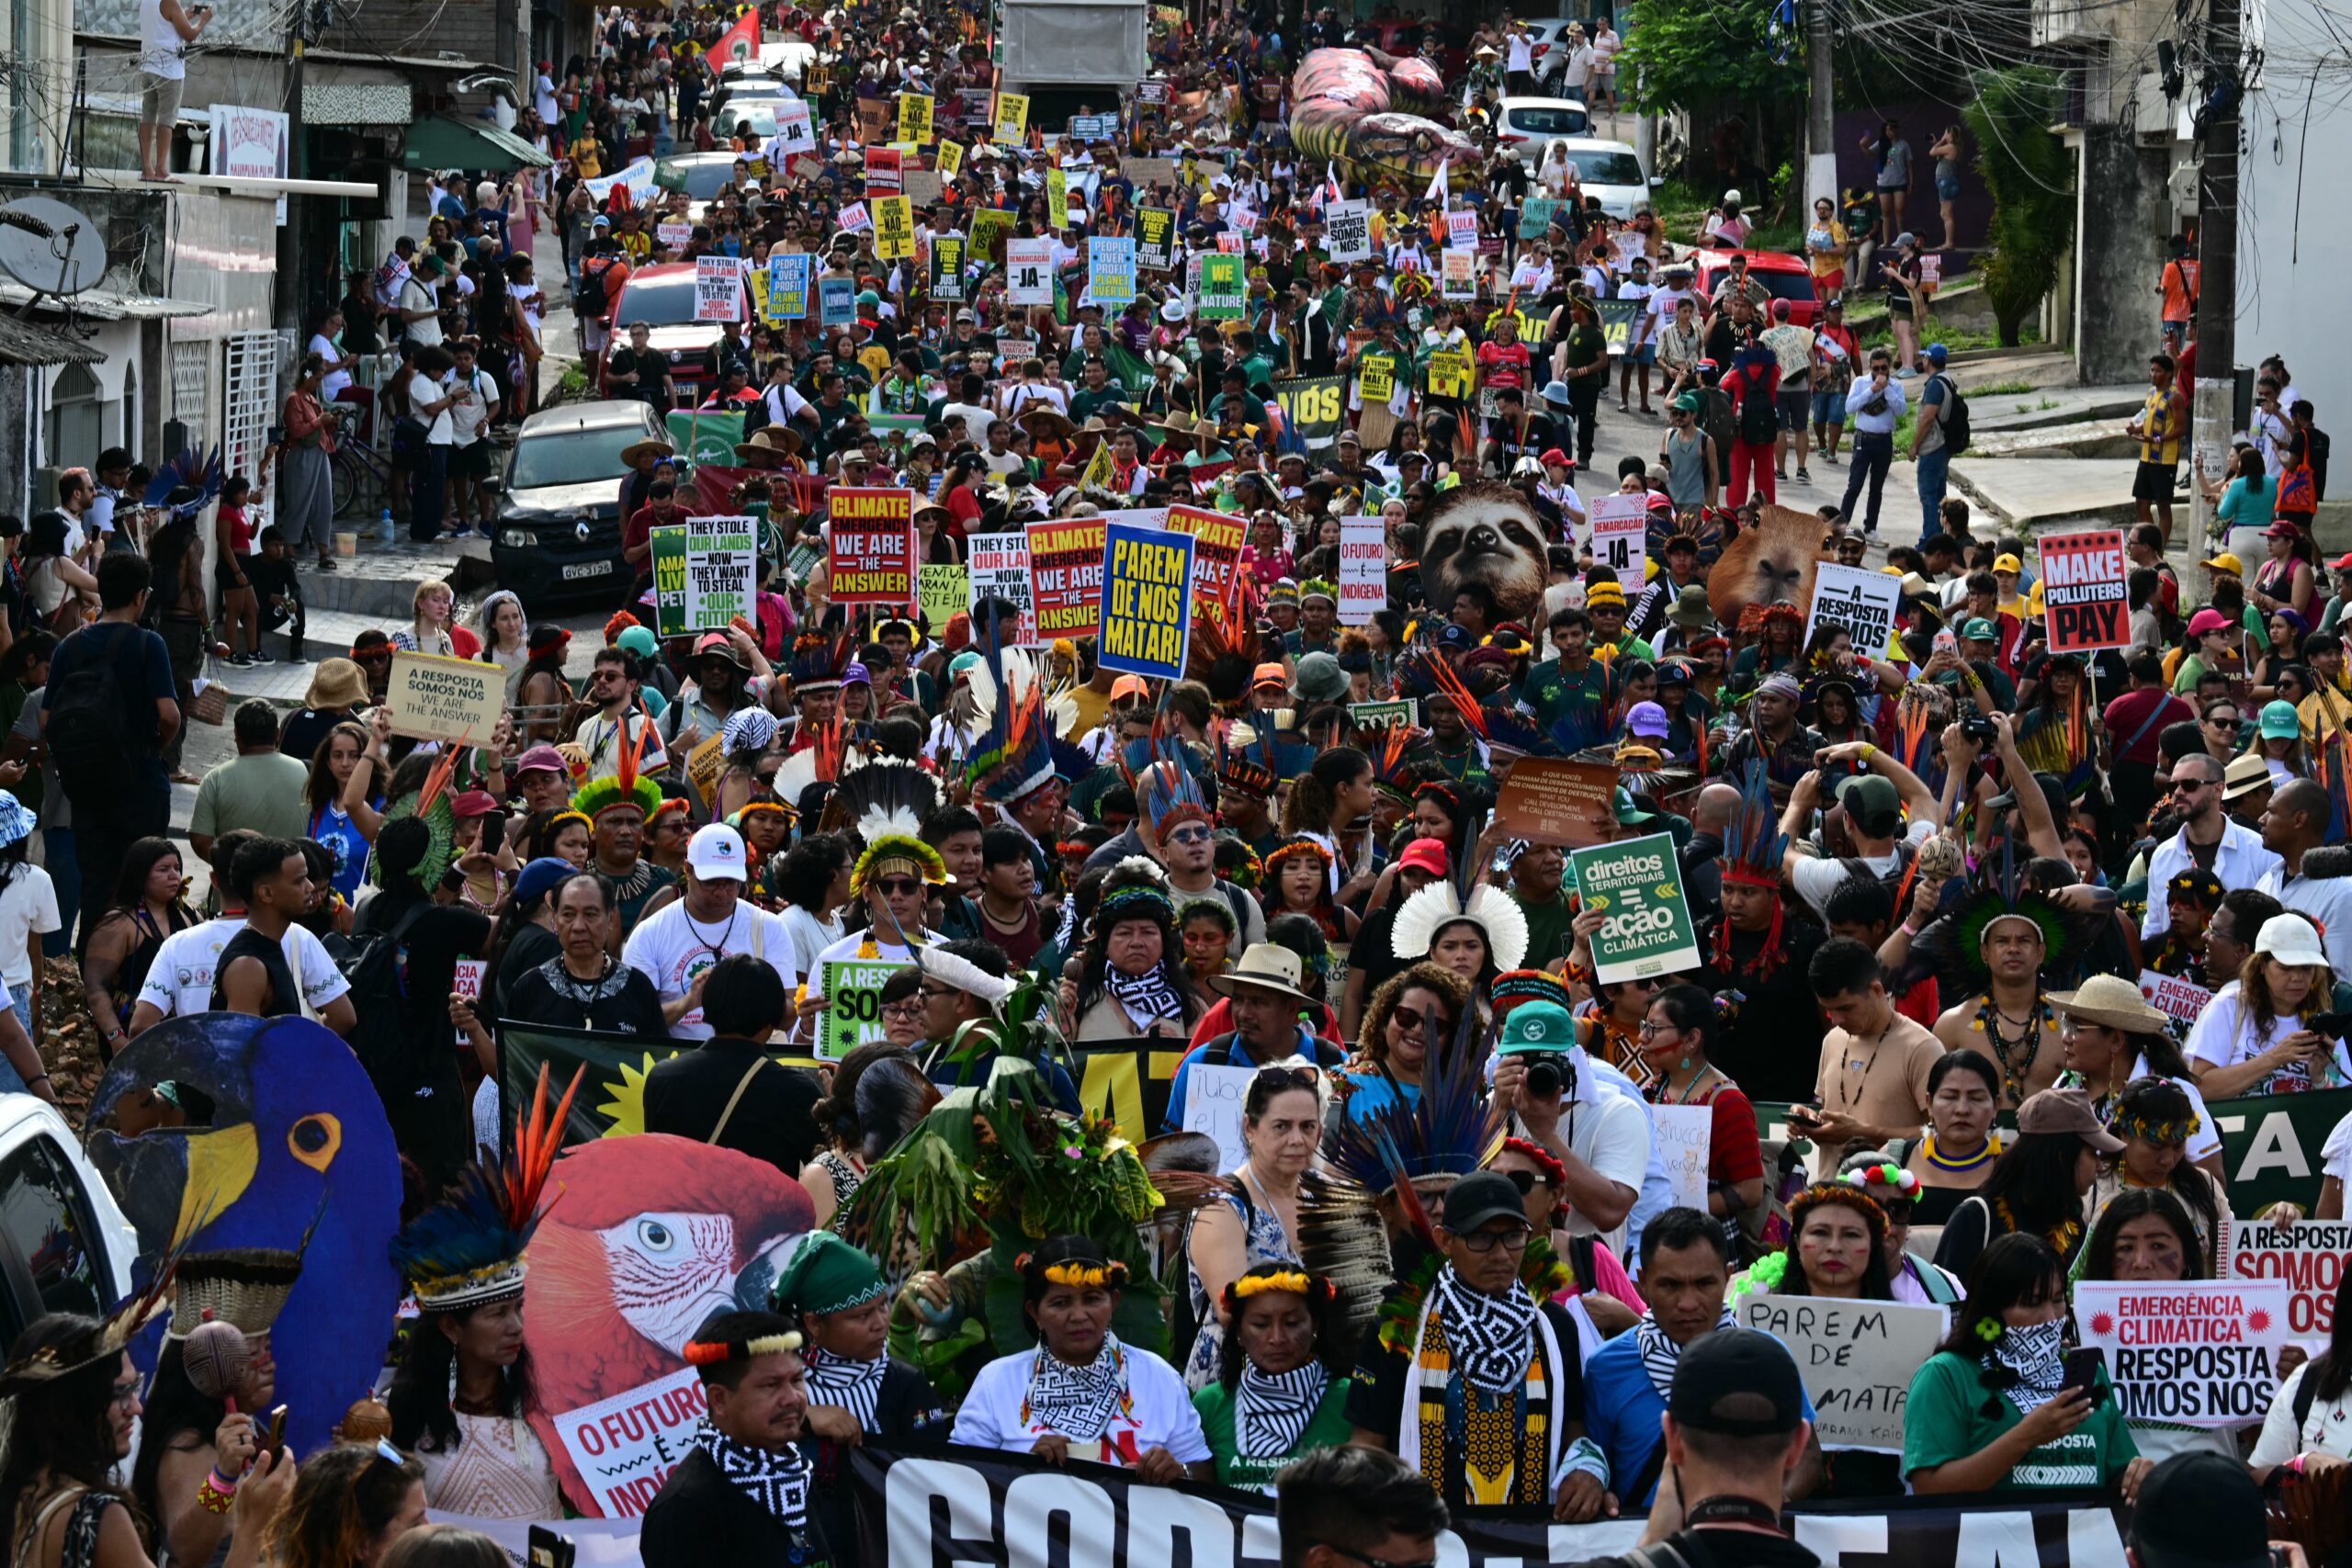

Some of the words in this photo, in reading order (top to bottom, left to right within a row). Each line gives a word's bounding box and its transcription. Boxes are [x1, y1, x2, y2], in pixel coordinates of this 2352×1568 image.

[874, 160, 893, 169] STOP
[866, 169, 899, 180] FUNDING
[866, 179, 899, 187] DESTRUCTION
[882, 198, 899, 207] MARCO
[842, 209, 865, 227] LULA
[880, 207, 904, 217] TEMPORAL
[1139, 210, 1170, 224] FOSSIL
[1143, 221, 1164, 234] FREE
[1329, 217, 1365, 229] RESPOSTA
[1452, 218, 1475, 229] LULA
[878, 231, 910, 243] DEMARCAÇÃO
[1331, 226, 1366, 242] SOMOS
[936, 240, 961, 252] FOSSIL
[1095, 242, 1129, 253] PEOPLE
[1139, 243, 1162, 254] JUST
[1340, 237, 1360, 254] NÓS
[698, 258, 717, 266] THEY
[718, 258, 738, 266] STOLE
[775, 258, 803, 269] PEOPLE
[939, 251, 958, 264] FREE
[1009, 254, 1050, 265] DEMARCAÇÃO
[1100, 253, 1125, 264] OVER
[1136, 252, 1167, 266] FUTURE
[698, 266, 715, 276] OUR
[716, 267, 738, 276] LAND
[778, 270, 799, 280] OVER
[1096, 264, 1128, 275] PROFIT
[1212, 265, 1234, 281] WE
[775, 280, 802, 291] PROFIT
[938, 273, 957, 286] JUST
[1094, 275, 1129, 287] PLANET
[698, 284, 716, 293] THEY
[717, 284, 737, 293] WANT
[711, 291, 732, 300] STEAL
[933, 286, 961, 297] FUTURE
[1092, 286, 1117, 298] OVER
[1118, 287, 1132, 298] OIL
[1211, 282, 1232, 295] ARE
[708, 299, 725, 308] OUR
[773, 292, 802, 303] PLANET
[826, 294, 850, 306] LIVRE
[1201, 295, 1242, 309] NATURE
[699, 309, 734, 320] HISTORY
[770, 303, 791, 313] OVER
[793, 304, 804, 314] OIL
[1431, 371, 1457, 381] GARIMPO
[1363, 389, 1387, 397] CUIDADA
[831, 496, 909, 518] CLIMATE
[689, 521, 715, 536] THEY
[717, 520, 749, 535] STOLE
[831, 518, 909, 533] EMERGENCY
[1594, 517, 1644, 534] DEMARCAÇÃO
[688, 536, 712, 551] OUR
[713, 535, 752, 551] LANDS
[834, 535, 865, 555] WE
[868, 534, 905, 555] ARE
[972, 538, 1003, 552] THEY
[1030, 526, 1105, 554] CLIMATE
[1341, 543, 1349, 558] O
[1350, 543, 1383, 559] FUTURO
[707, 552, 732, 566] NOW
[857, 557, 880, 570] THE
[973, 553, 1003, 570] OUR
[1032, 551, 1104, 570] EMERGENCY
[1112, 538, 1185, 587] PAREM
[691, 567, 717, 581] THEY
[718, 565, 751, 580] WANT
[1361, 562, 1365, 577] É
[2044, 549, 2122, 586] MAKE
[831, 572, 908, 593] ANSWER
[995, 570, 1023, 583] NOW
[1036, 570, 1067, 592] WE
[1070, 566, 1103, 589] ARE
[696, 580, 710, 593] TO
[712, 579, 745, 592] STEAL
[1340, 581, 1384, 599] INDÍGENA
[1849, 585, 1861, 602] A
[2047, 581, 2124, 605] POLLUTERS
[707, 593, 735, 610] OUR
[1060, 592, 1082, 606] THE
[1111, 579, 1135, 618] DE
[1137, 584, 1182, 625] NOS
[1815, 596, 1889, 625] RESPOSTA
[2054, 602, 2120, 647] PAY
[1104, 617, 1182, 668] MATAR!
[409, 669, 418, 679] A
[421, 671, 484, 690] RESPOSTA
[408, 680, 456, 696] SOMOS
[458, 687, 484, 701] NÓS
[421, 694, 440, 705] WE
[443, 697, 465, 710] ARE
[406, 703, 426, 716] THE
[430, 707, 481, 725] ANSWER
[1356, 705, 1407, 716] DESMATAMENTO
[1510, 773, 1540, 783] CHAMAM
[1549, 778, 1607, 794] DESENVOLVIMENTO,
[1562, 773, 1582, 781] VOCÊS
[1507, 780, 1521, 788] NÓS
[1521, 783, 1558, 793] CHAMAMOS
[1568, 788, 1608, 802] DESTRUIÇÃO,
[1524, 798, 1538, 807] CALL
[1539, 800, 1581, 813] DEVELOPMENT,
[1529, 807, 1544, 815] CALL
[1544, 808, 1587, 821] DESTRUCTION.
[1585, 854, 1663, 882] direitos
[1588, 870, 1666, 893] TERRITORIAIS
[1600, 902, 1674, 940] ação
[1603, 930, 1679, 954] CLIMÁTICA
[839, 967, 853, 987] A
[2237, 1227, 2252, 1249] A
[2119, 1292, 2244, 1317] EMERGÊNCIA
[1749, 1302, 1887, 1340] PAREM
[2119, 1314, 2243, 1346] CLIMÁTICA
[1811, 1344, 1853, 1367] DE
[2116, 1347, 2272, 1381] RESPOSTA
[2208, 1376, 2274, 1416] NÓS
[577, 1423, 606, 1457] O
[654, 1433, 676, 1464] É
[1229, 1455, 1241, 1468] A
